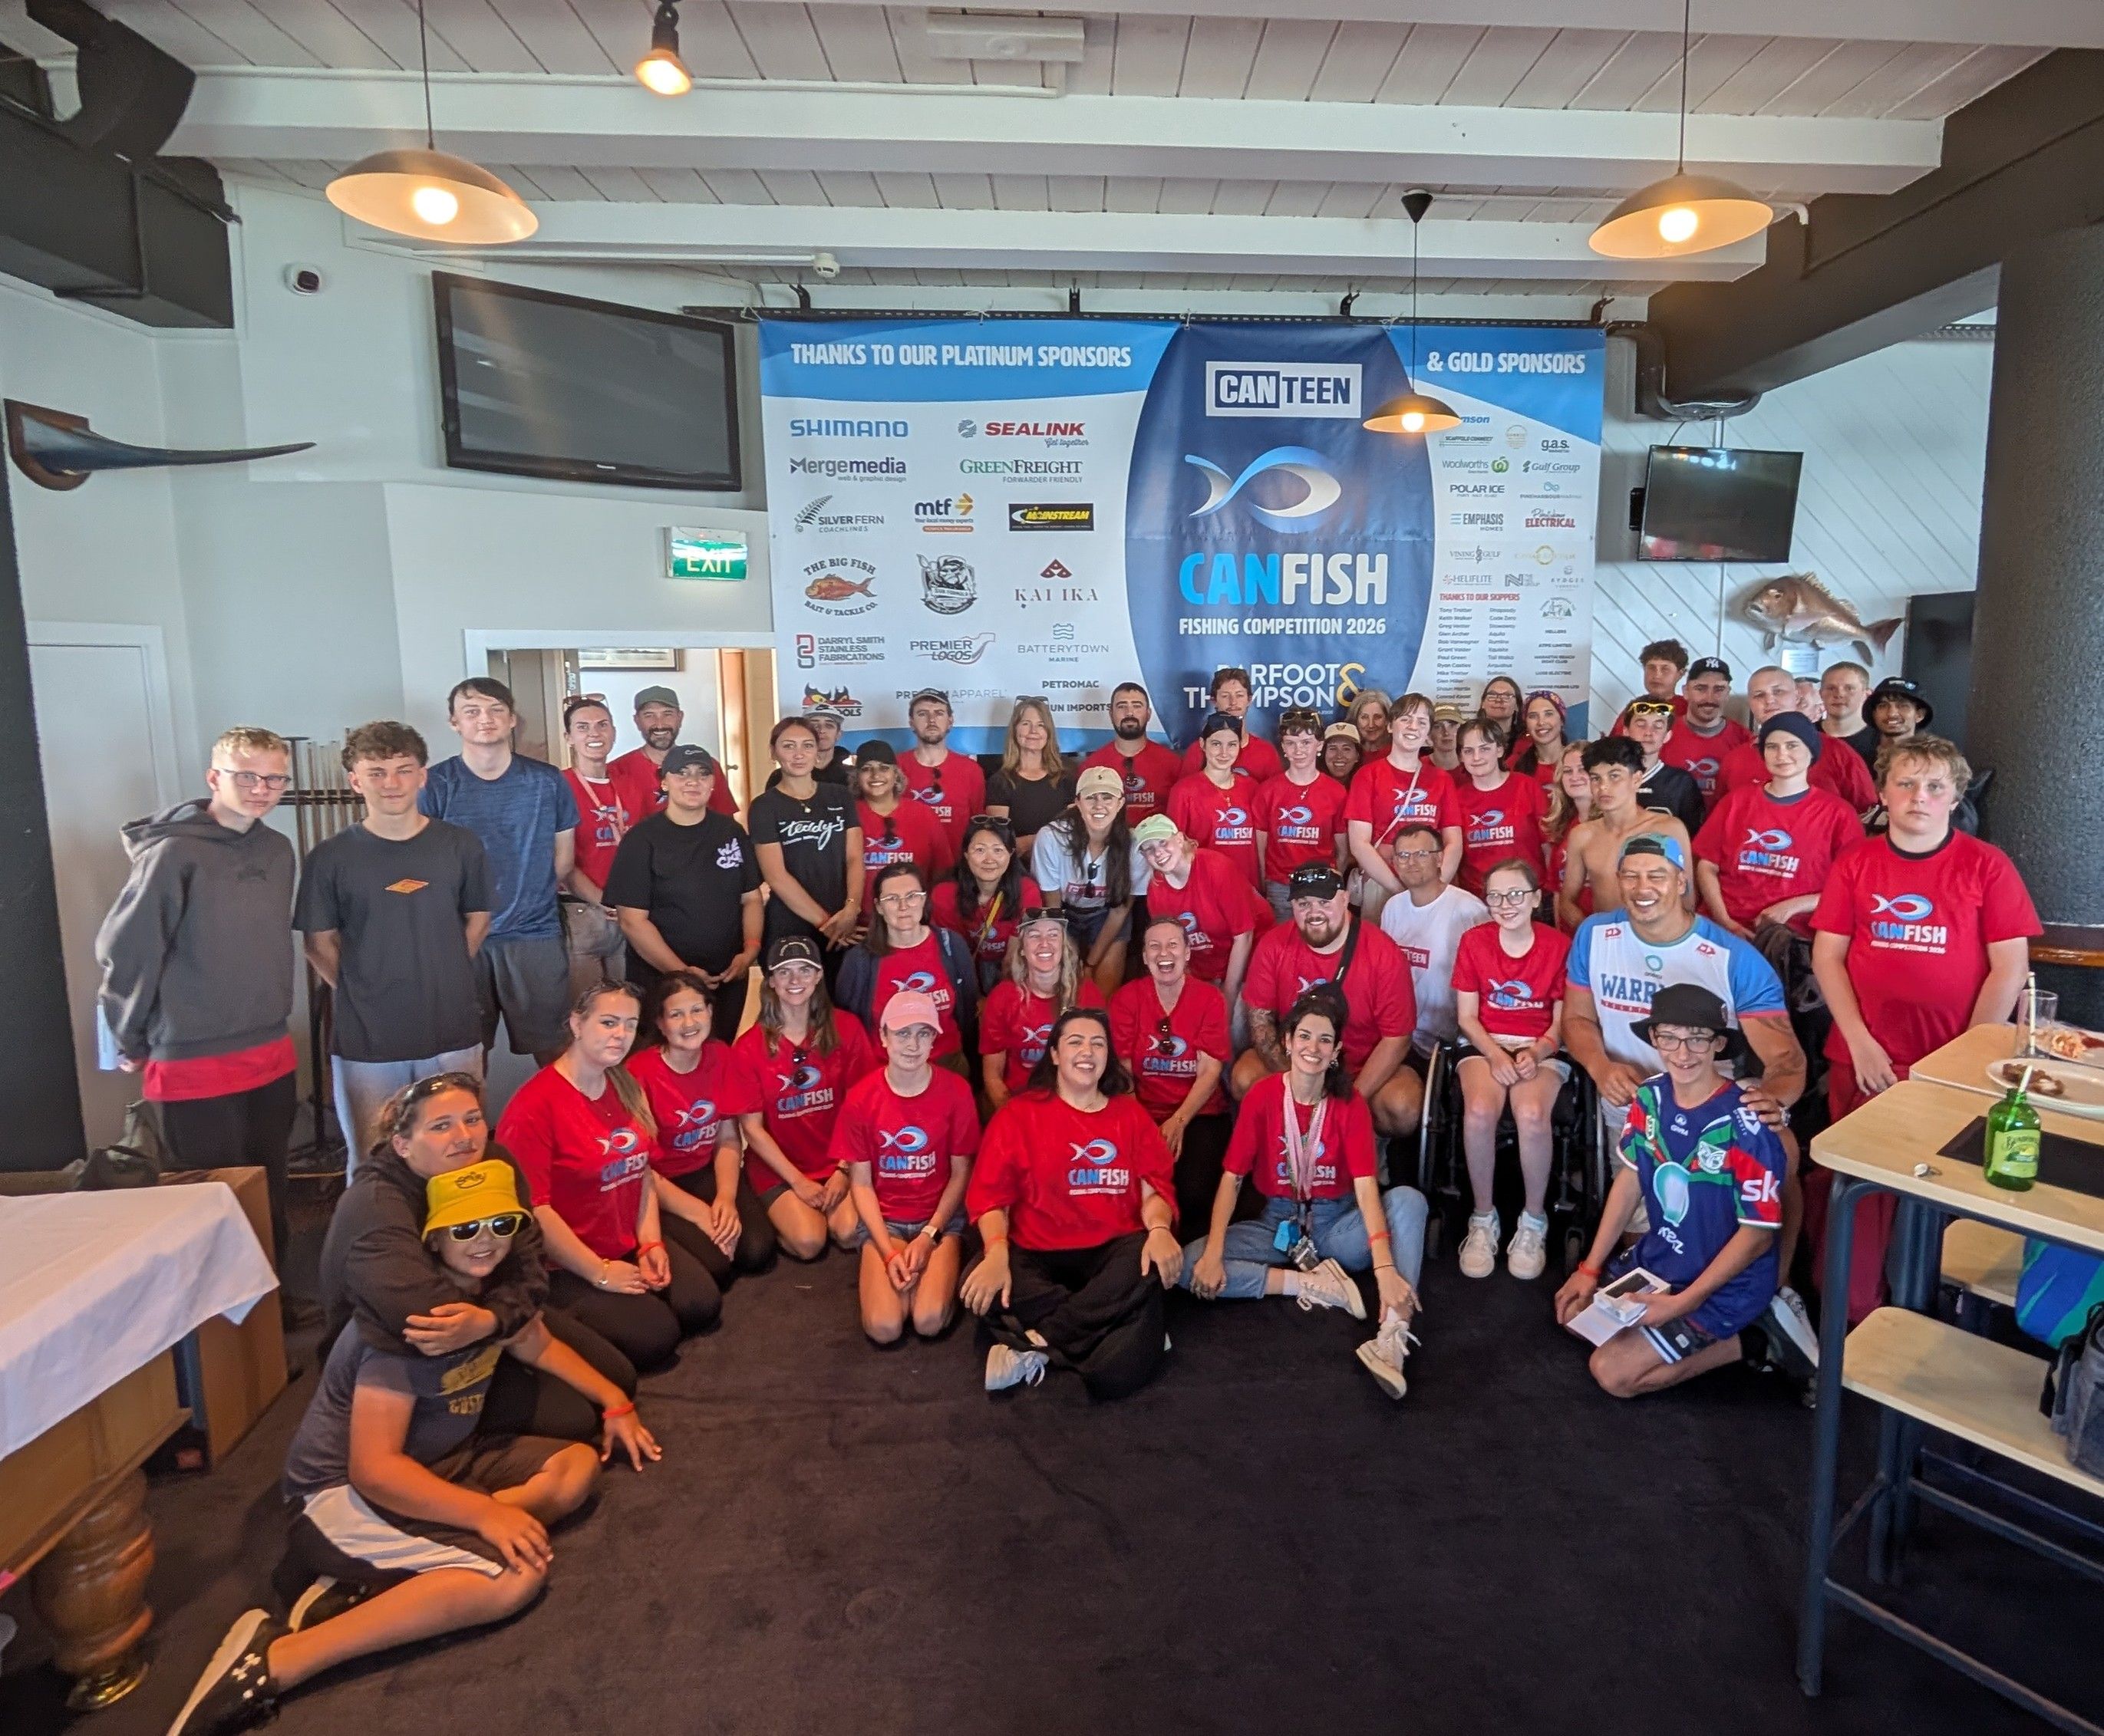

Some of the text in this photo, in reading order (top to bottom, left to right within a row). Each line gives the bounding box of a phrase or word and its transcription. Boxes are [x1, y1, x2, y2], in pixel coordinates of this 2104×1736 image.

[791, 344, 1131, 367] THANKS TO OUR PLATINUM SPONSORS
[1427, 351, 1585, 374] & GOLD SPONSORS
[790, 420, 909, 437] SHIMANO
[985, 422, 1086, 436] SEALINK
[790, 456, 906, 477] Mergemedia
[1443, 459, 1489, 469] Woolworths
[1532, 462, 1580, 473] Gulf Group
[1450, 485, 1505, 493] POLAR ICE
[915, 498, 952, 516] mtf
[818, 516, 884, 525] SILVER FERN
[1463, 513, 1504, 525] EMPHASIS
[1525, 518, 1575, 528] ELECTRICAL
[687, 556, 730, 573] EXIT
[803, 558, 876, 575] THE BIG FISH
[1179, 553, 1388, 605] CANFISH
[1015, 588, 1098, 601] KAI IKA
[804, 601, 824, 613] BAIT
[834, 607, 865, 616] TACKLE
[1179, 617, 1386, 634] FISHING COMPETITION 2026
[910, 640, 973, 650] PREMIER
[1017, 644, 1110, 653] BATTERYTOWN
[819, 653, 885, 661] FABRICATIONS
[932, 651, 972, 660] LOGOS
[1217, 664, 1341, 686] RFOOT
[896, 689, 1004, 699] PREM APPAREL
[1183, 686, 1334, 708] THMPSON
[1049, 703, 1113, 712] UN IMPORTS
[780, 815, 845, 851] teddy's
[1215, 827, 1253, 839] CANFISH
[1278, 826, 1320, 838] CANFISH
[1468, 825, 1514, 842] CANFISH
[863, 852, 913, 863] CANFISH
[1740, 850, 1799, 871] CANFISH
[1871, 921, 1947, 944] CANFISH
[1601, 973, 1659, 1004] WARR
[1143, 1057, 1197, 1072] CANFISH
[778, 1088, 833, 1111] CANFISH
[674, 1122, 718, 1150] CANFIS
[879, 1151, 935, 1171] CANFISH
[1069, 1168, 1129, 1186] CANFISH
